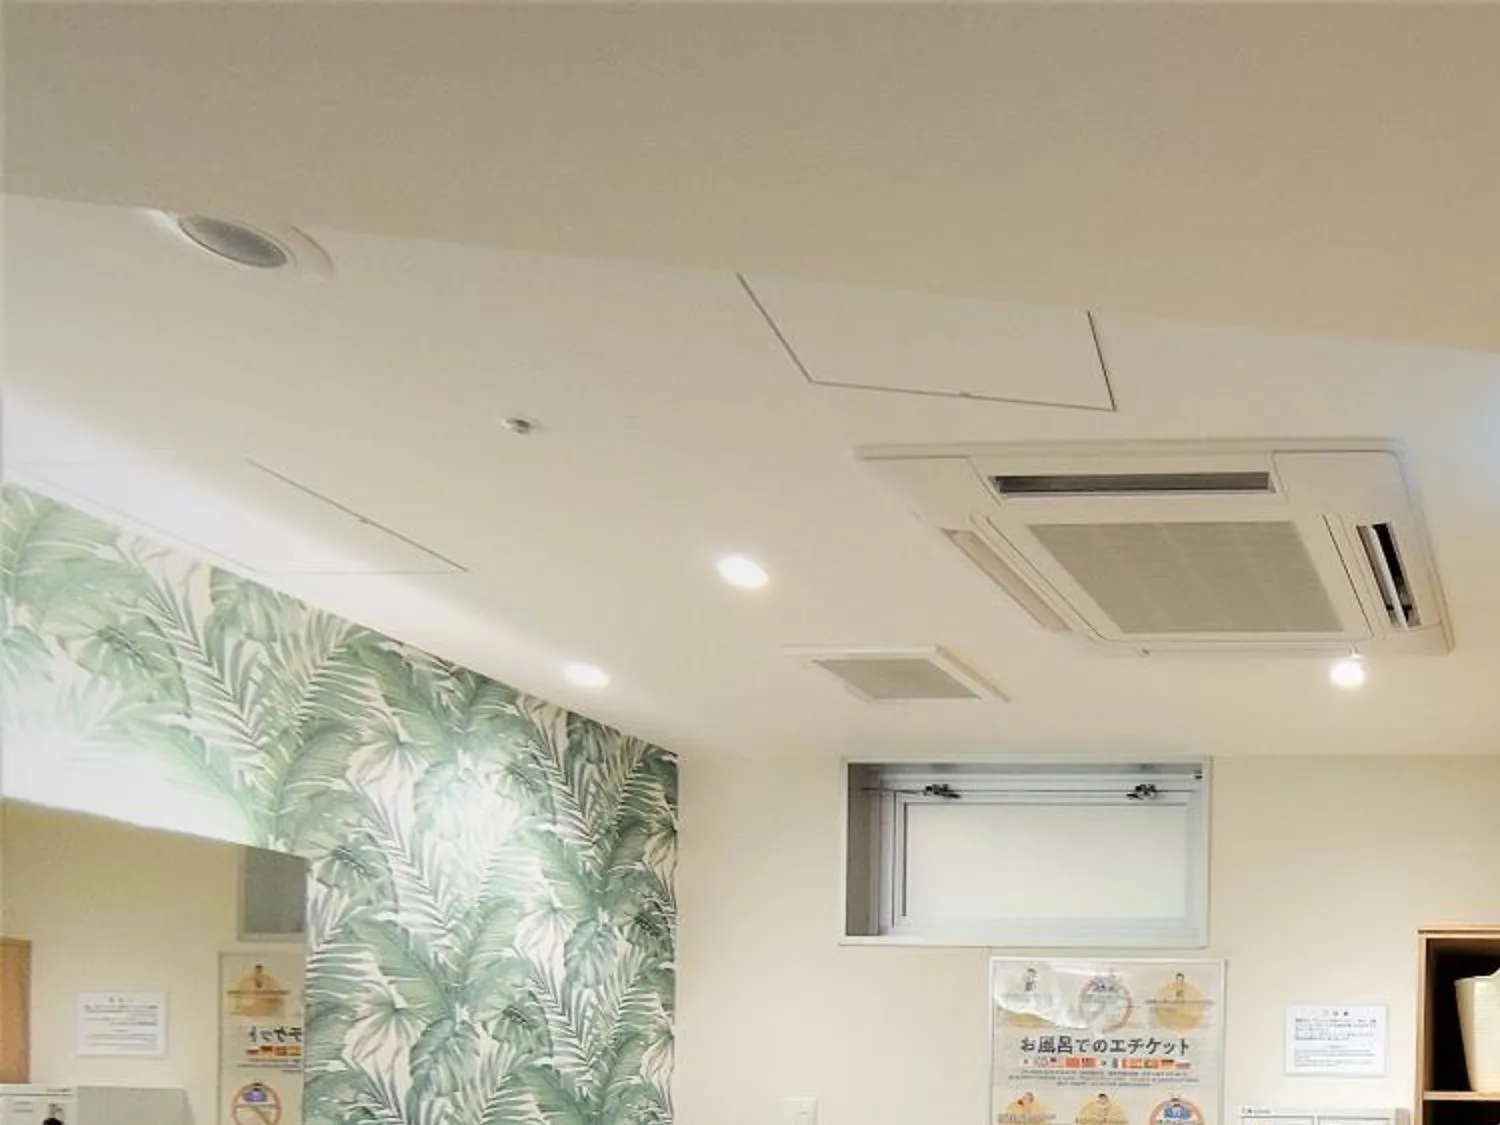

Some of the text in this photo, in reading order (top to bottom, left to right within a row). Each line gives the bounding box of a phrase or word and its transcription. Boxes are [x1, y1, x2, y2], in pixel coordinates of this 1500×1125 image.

[1021, 1035, 1190, 1056] お風呂でのエチケット
